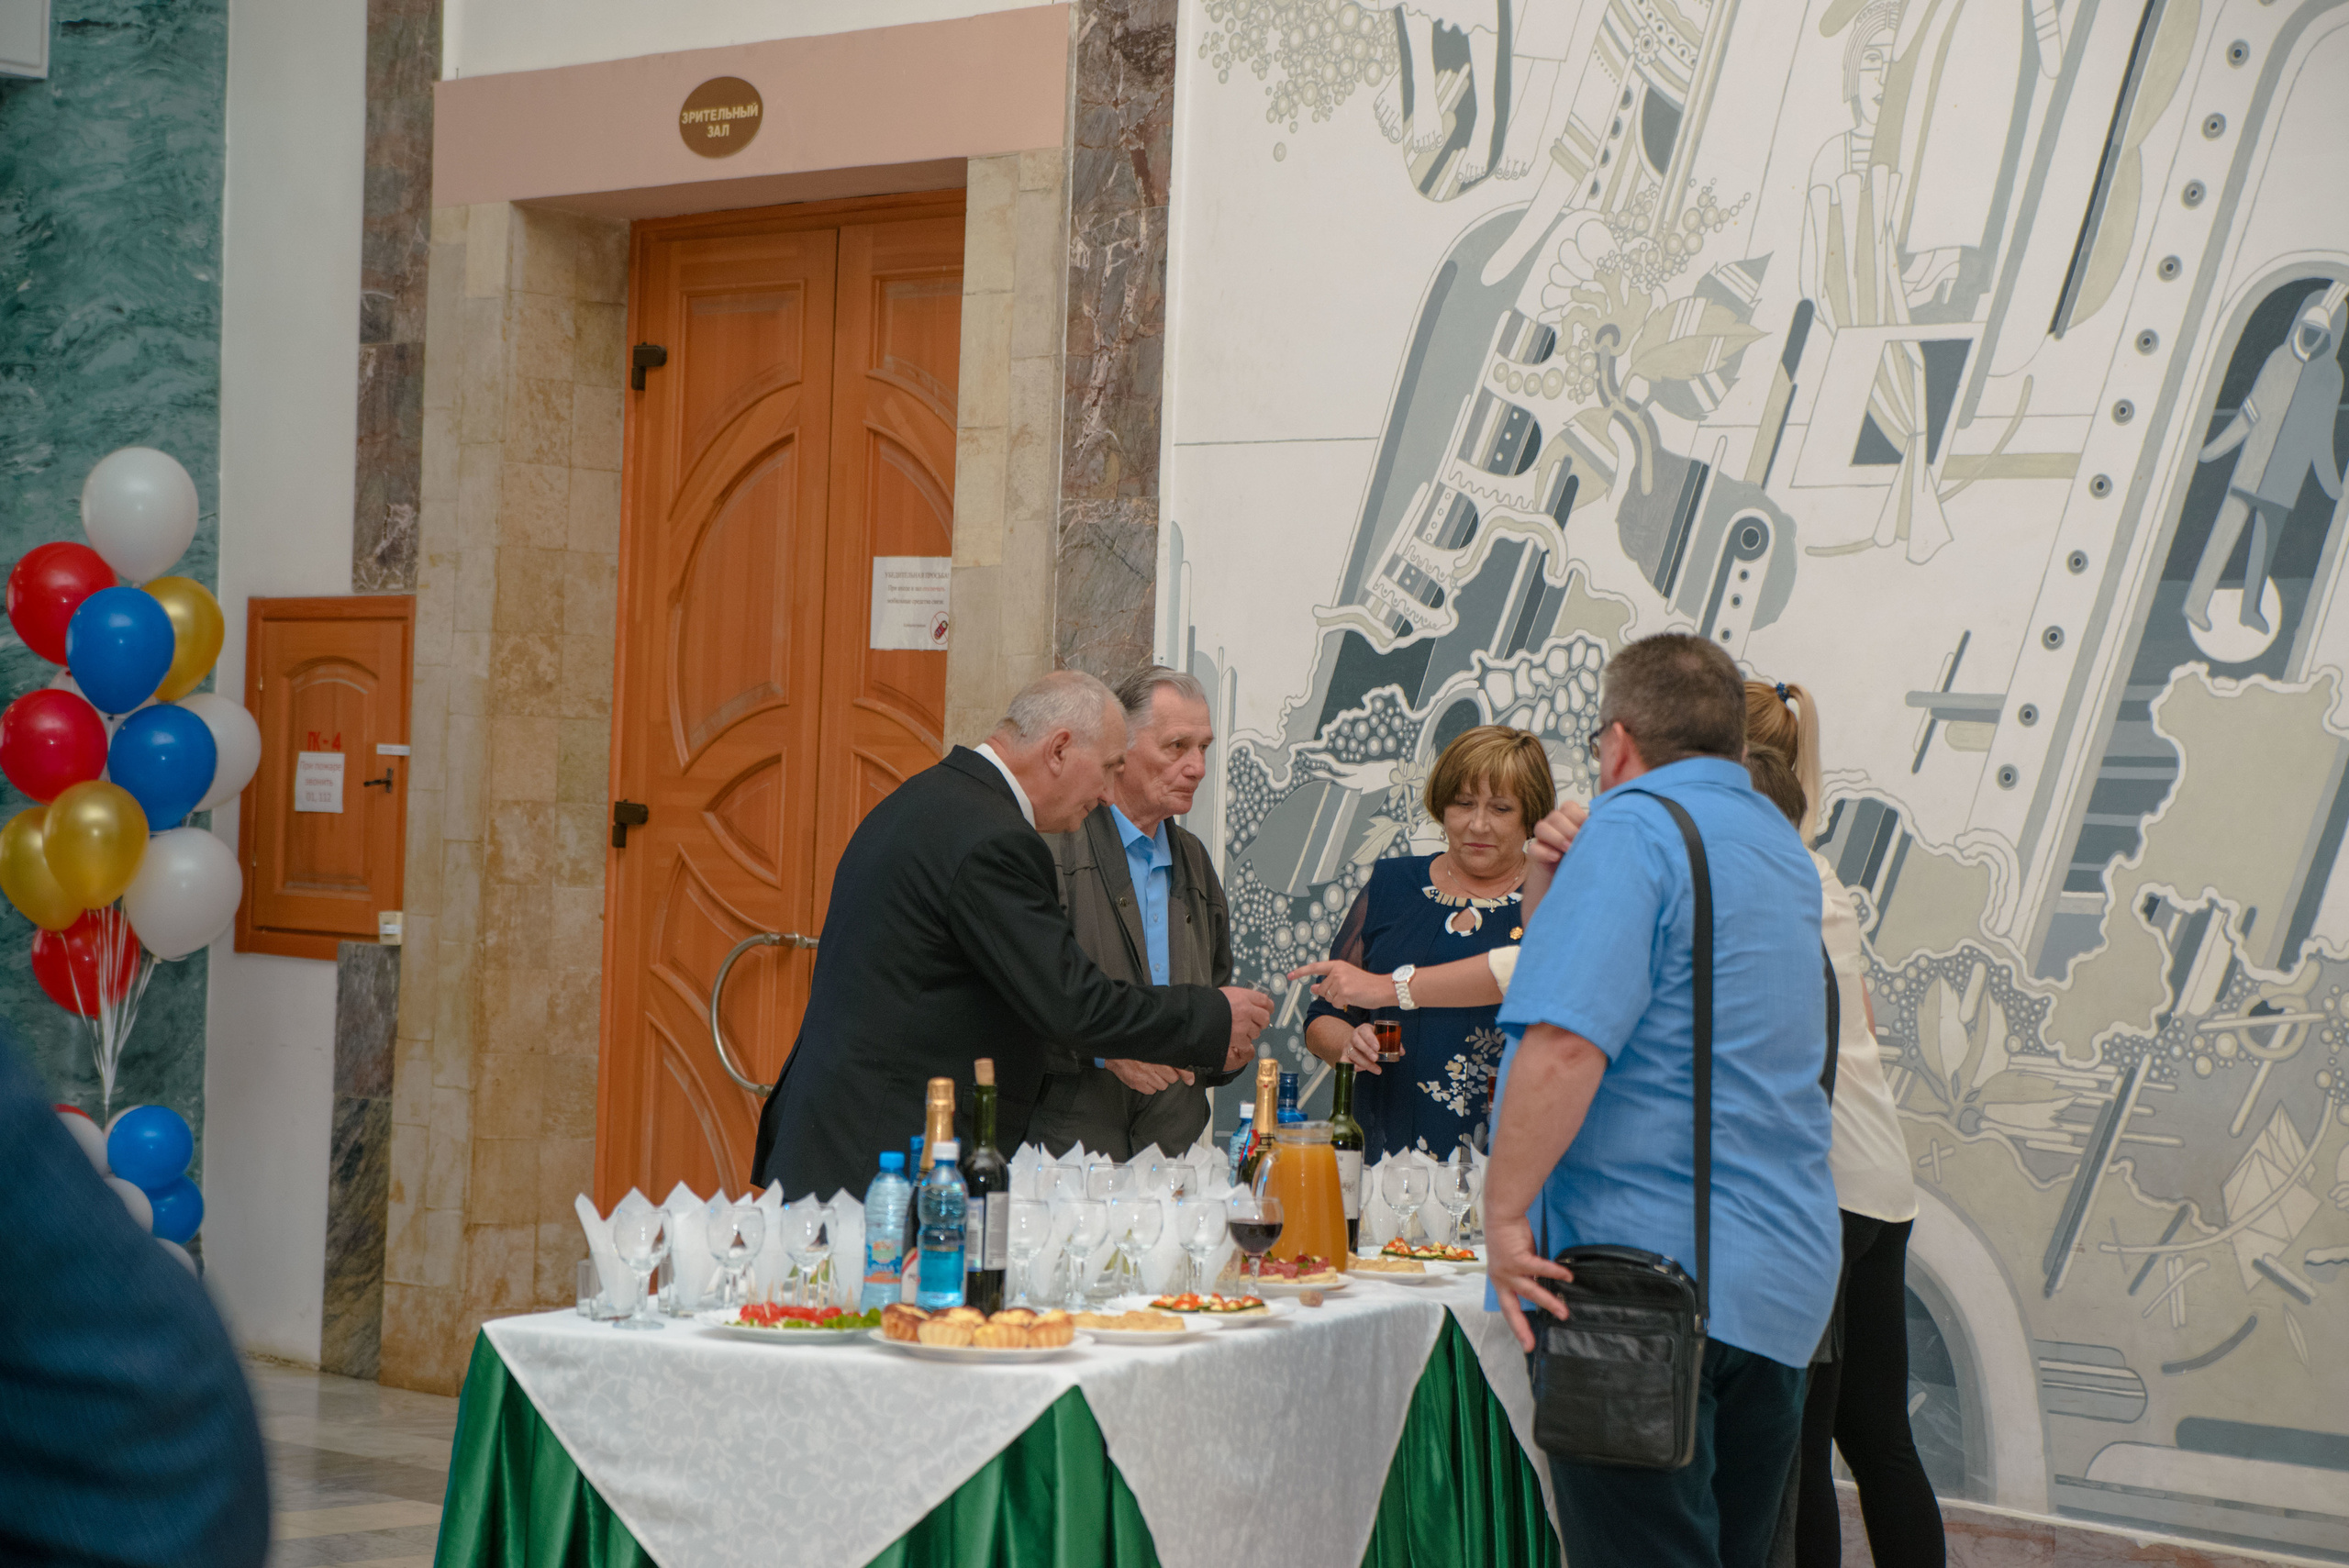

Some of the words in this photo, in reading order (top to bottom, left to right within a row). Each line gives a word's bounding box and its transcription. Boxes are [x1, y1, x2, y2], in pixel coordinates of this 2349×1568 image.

[682, 102, 759, 124] ЗРИТЕЛЬНЫЙ
[707, 124, 729, 139] ЗАЛ
[299, 761, 314, 772] При
[315, 762, 342, 773] пожаре
[305, 778, 334, 786] звонить
[319, 792, 331, 803] 112
